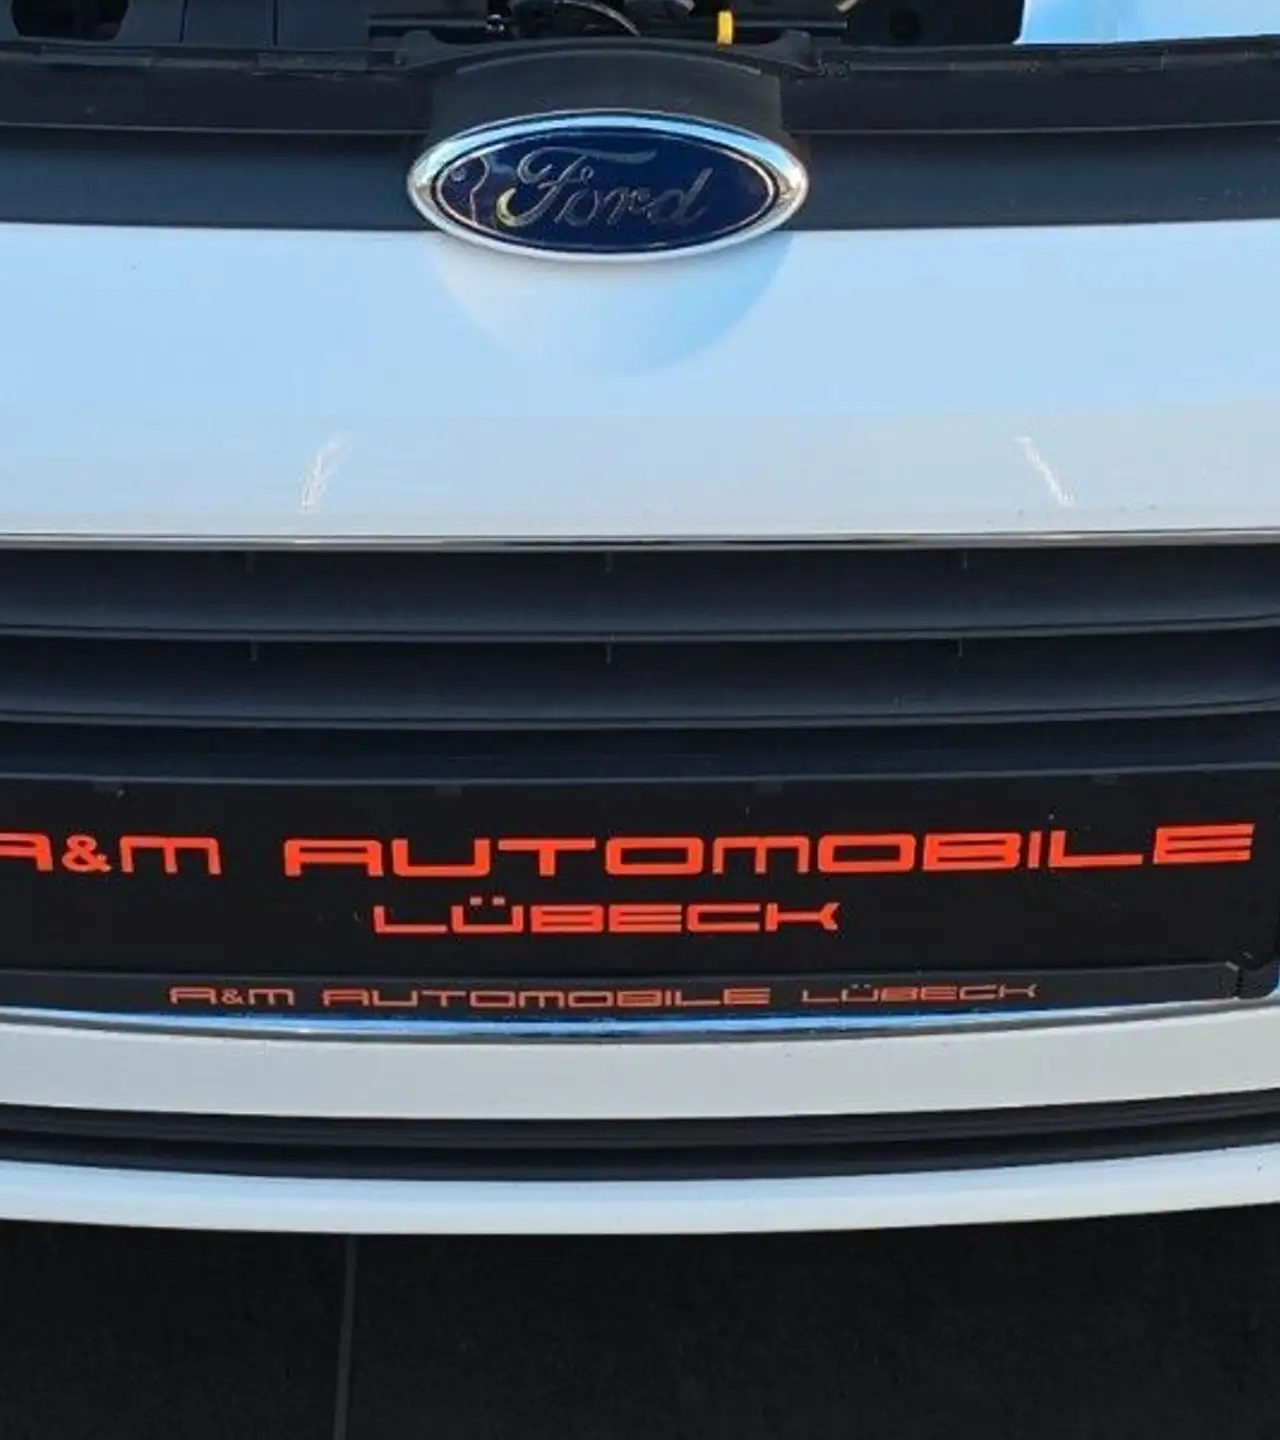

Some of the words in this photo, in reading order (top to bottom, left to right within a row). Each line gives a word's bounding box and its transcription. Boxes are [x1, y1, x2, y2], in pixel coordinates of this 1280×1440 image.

[495, 145, 716, 228] Ford
[282, 822, 1255, 879] AUTOMOBILE
[372, 895, 841, 935] LÜBECK
[169, 984, 296, 1007] A&M
[322, 986, 772, 1009] AUTOMOBILE
[801, 982, 1039, 1005] LÜBECK
